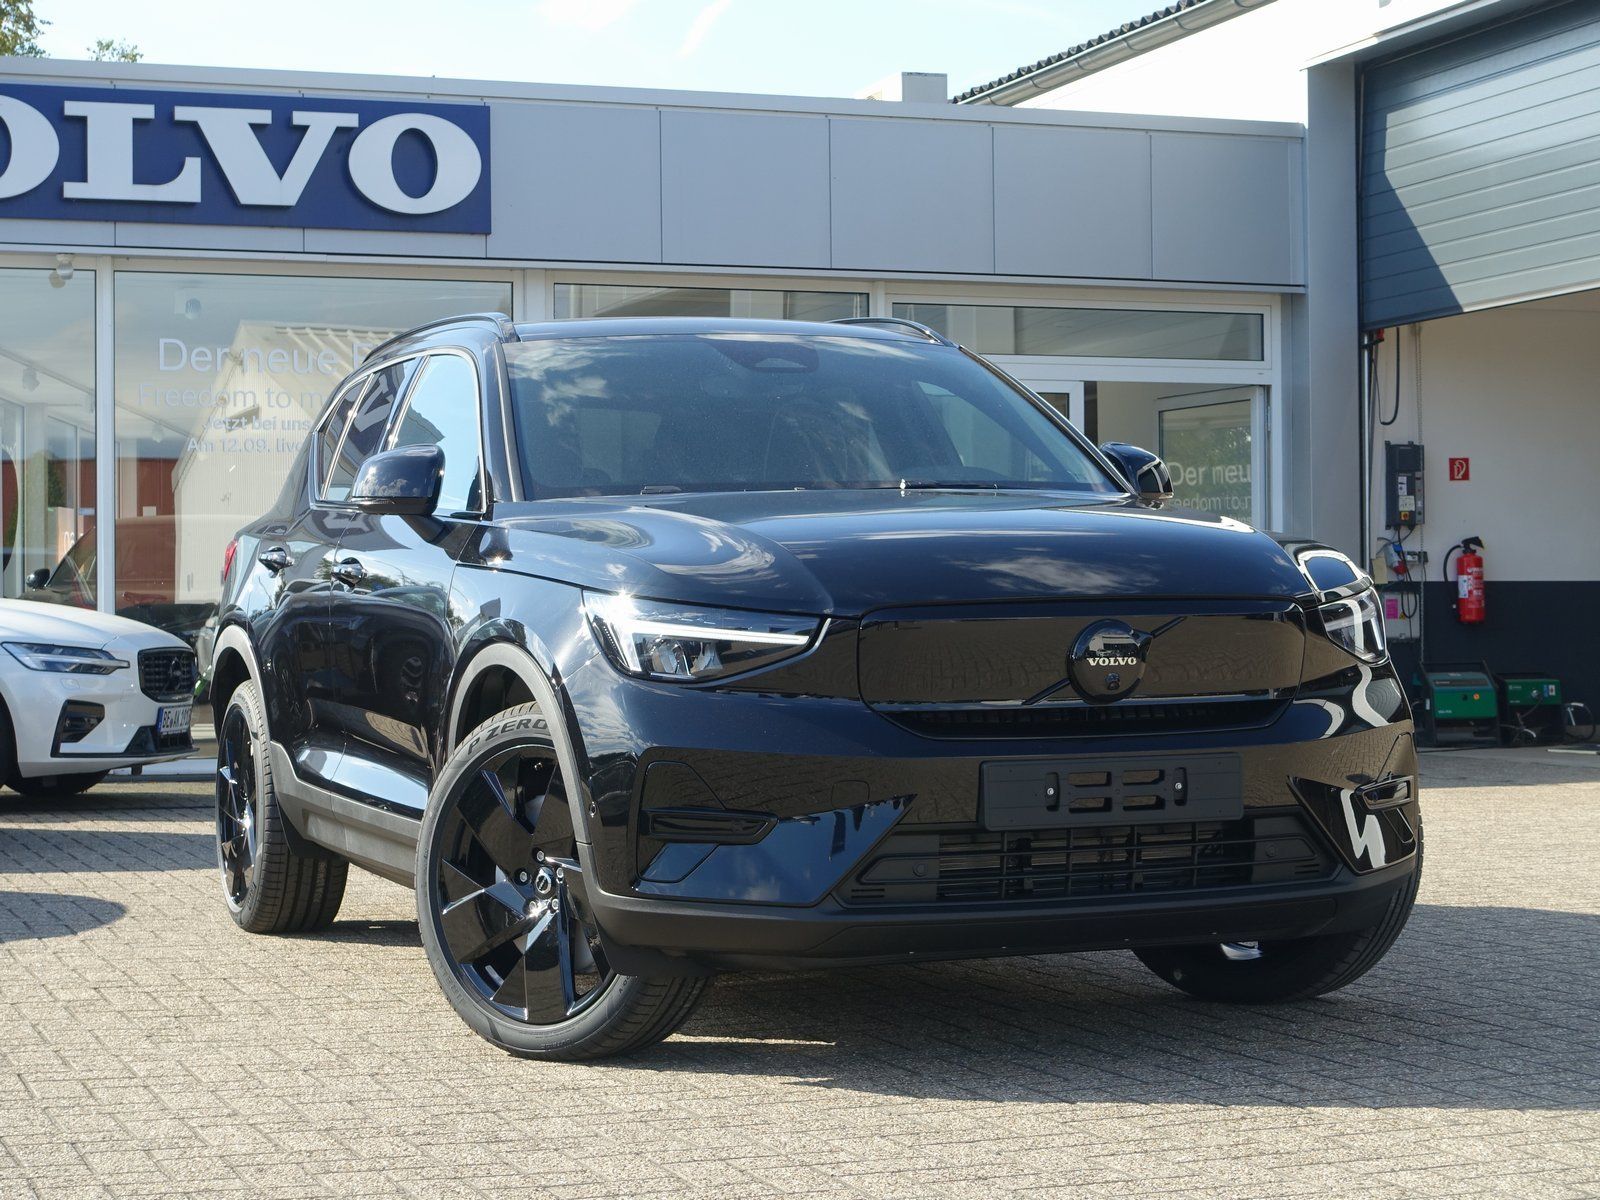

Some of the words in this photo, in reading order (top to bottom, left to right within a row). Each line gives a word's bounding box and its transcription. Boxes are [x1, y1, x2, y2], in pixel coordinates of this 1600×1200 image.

[159, 338, 230, 372] Der
[241, 346, 338, 375] neue
[139, 383, 257, 409] Freedom
[265, 387, 292, 409] to
[300, 390, 328, 410] m
[252, 415, 277, 431] bei
[281, 418, 311, 431] uns
[187, 438, 214, 453] Am
[221, 437, 270, 453] 12.09.
[1166, 461, 1206, 486] Der
[1086, 656, 1137, 667] VOLVO
[467, 737, 480, 755] P
[485, 718, 549, 741] ZERO
